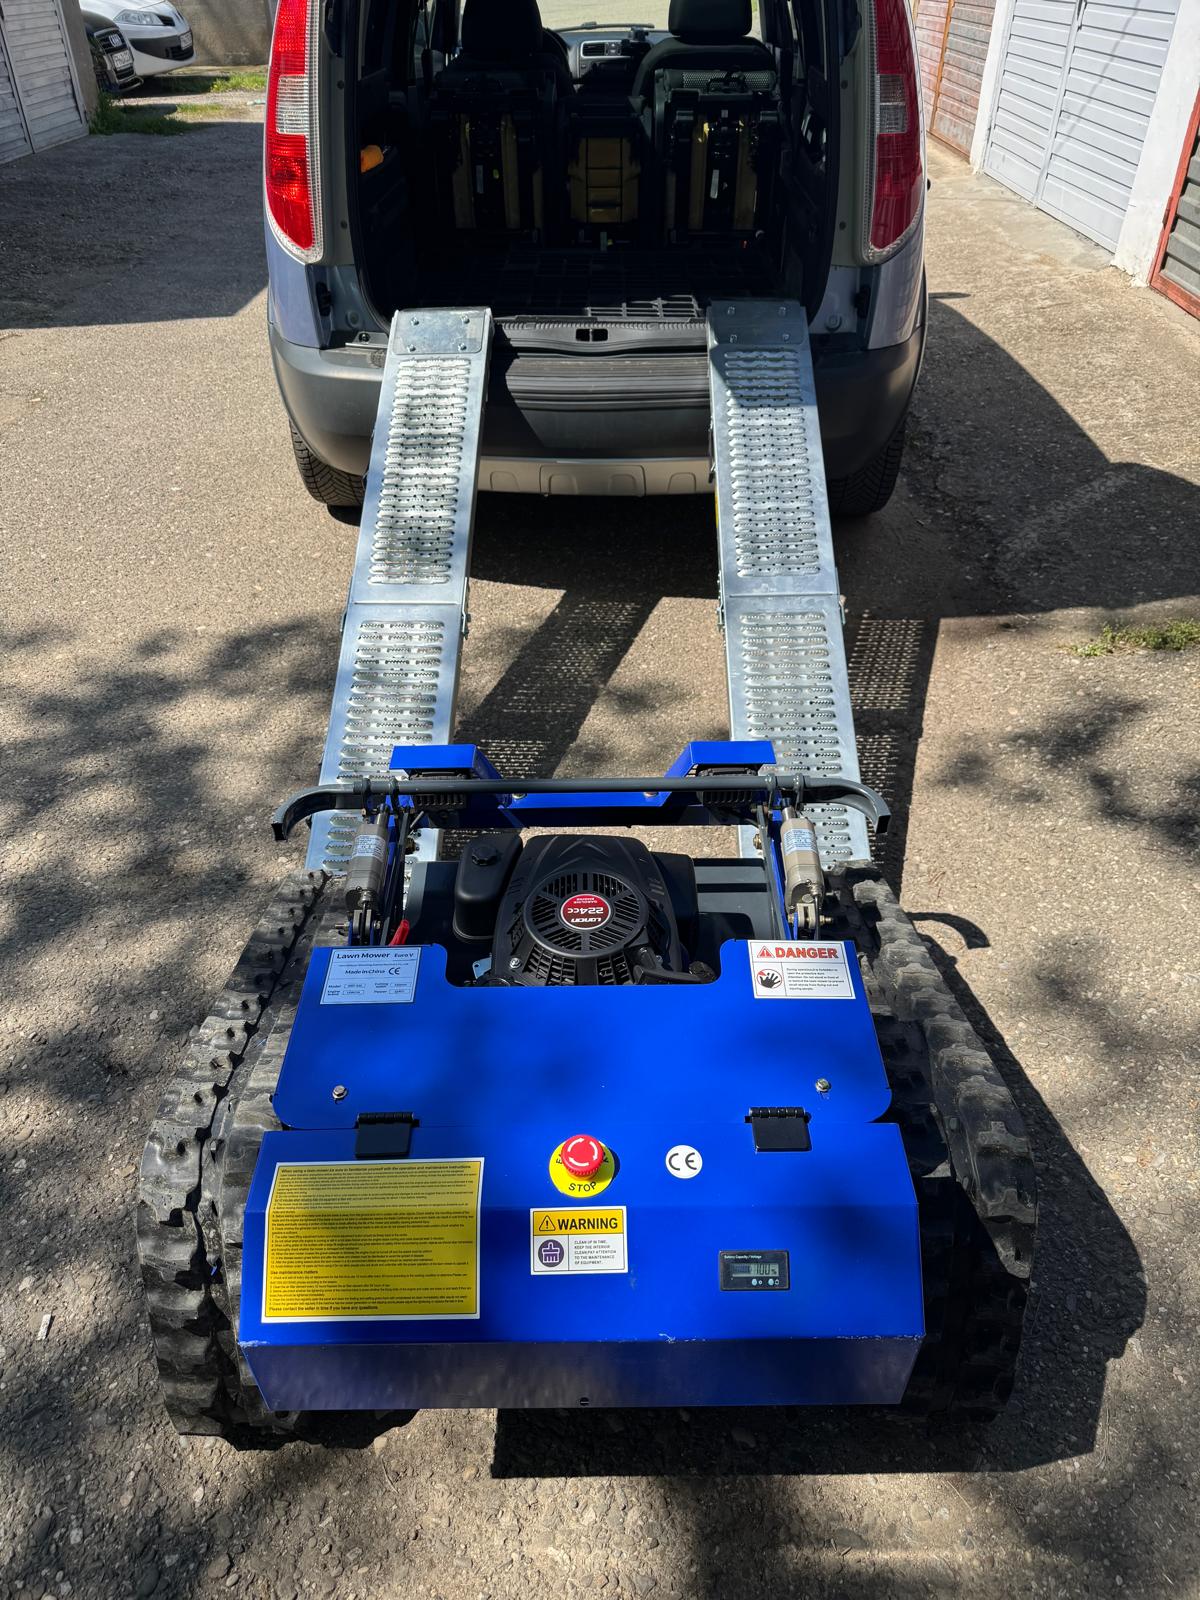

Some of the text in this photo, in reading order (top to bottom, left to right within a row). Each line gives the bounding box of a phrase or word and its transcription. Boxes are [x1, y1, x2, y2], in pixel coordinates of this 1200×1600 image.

[774, 946, 839, 958] DANGER
[388, 967, 400, 975] CE
[668, 1152, 697, 1171] CE
[568, 1181, 597, 1192] STOP
[558, 1218, 618, 1230] WARNING
